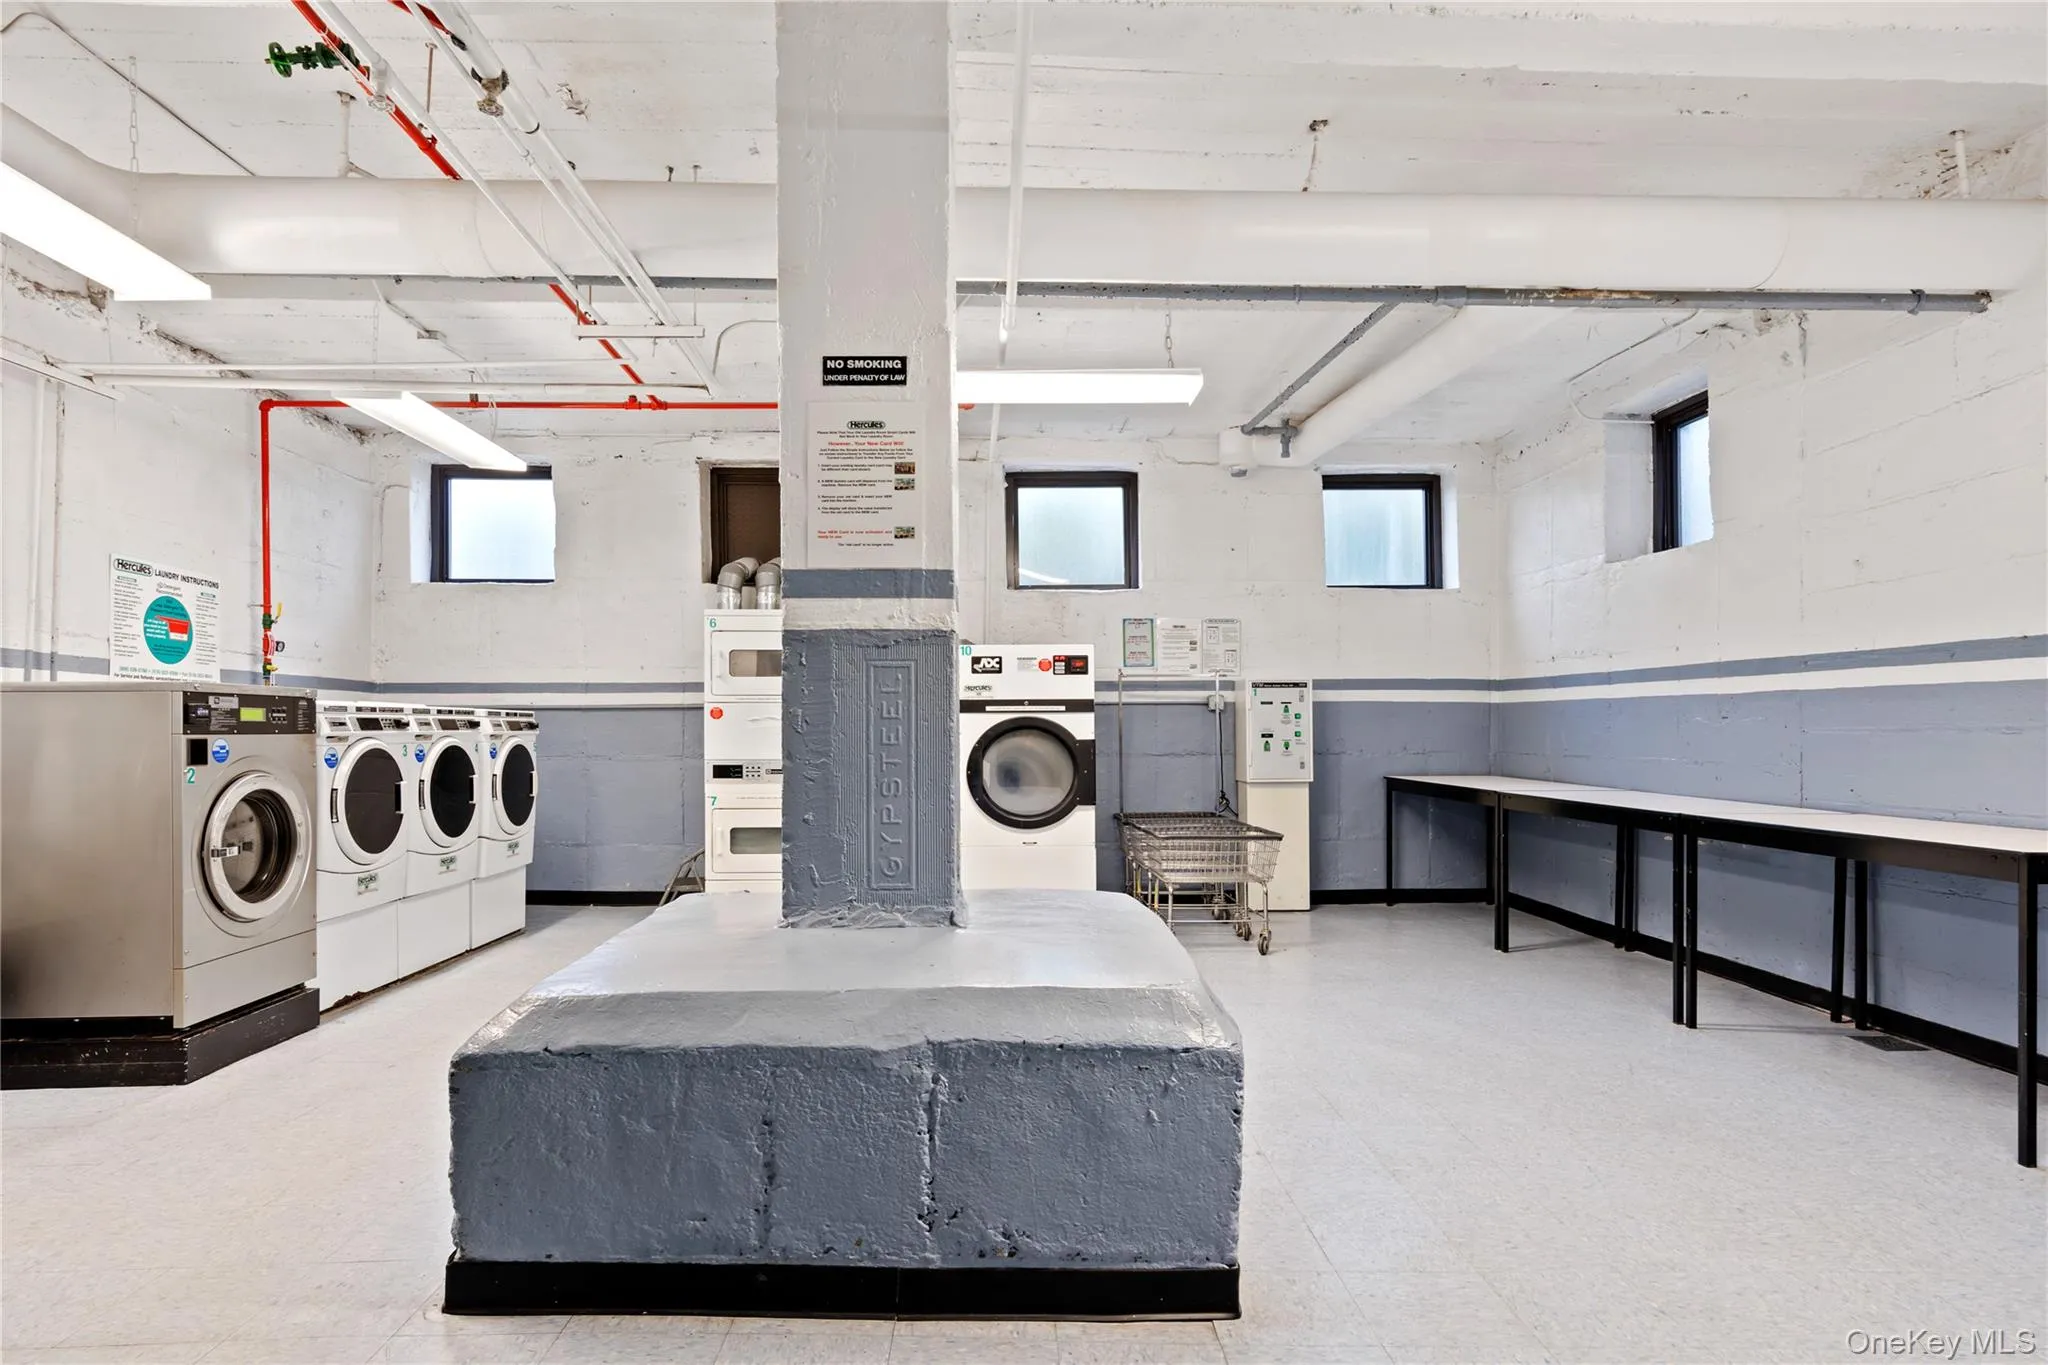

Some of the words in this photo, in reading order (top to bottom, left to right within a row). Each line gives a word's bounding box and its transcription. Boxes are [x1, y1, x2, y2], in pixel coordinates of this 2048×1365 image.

[827, 359, 844, 369] NO
[847, 359, 902, 369] SMOKING
[824, 374, 848, 382] UNDER
[849, 374, 879, 382] PENALTY
[880, 374, 889, 382] OF
[850, 421, 883, 429] Hercules
[117, 559, 152, 575] Hercules
[155, 570, 179, 581] LAUNDRY
[180, 575, 219, 589] INSTRUCTIONS
[709, 618, 717, 628] 6
[960, 646, 972, 656] 10
[402, 744, 408, 757] 3
[186, 768, 195, 784] 2
[880, 673, 902, 878] GYPSTEEL
[711, 796, 717, 806] 7
